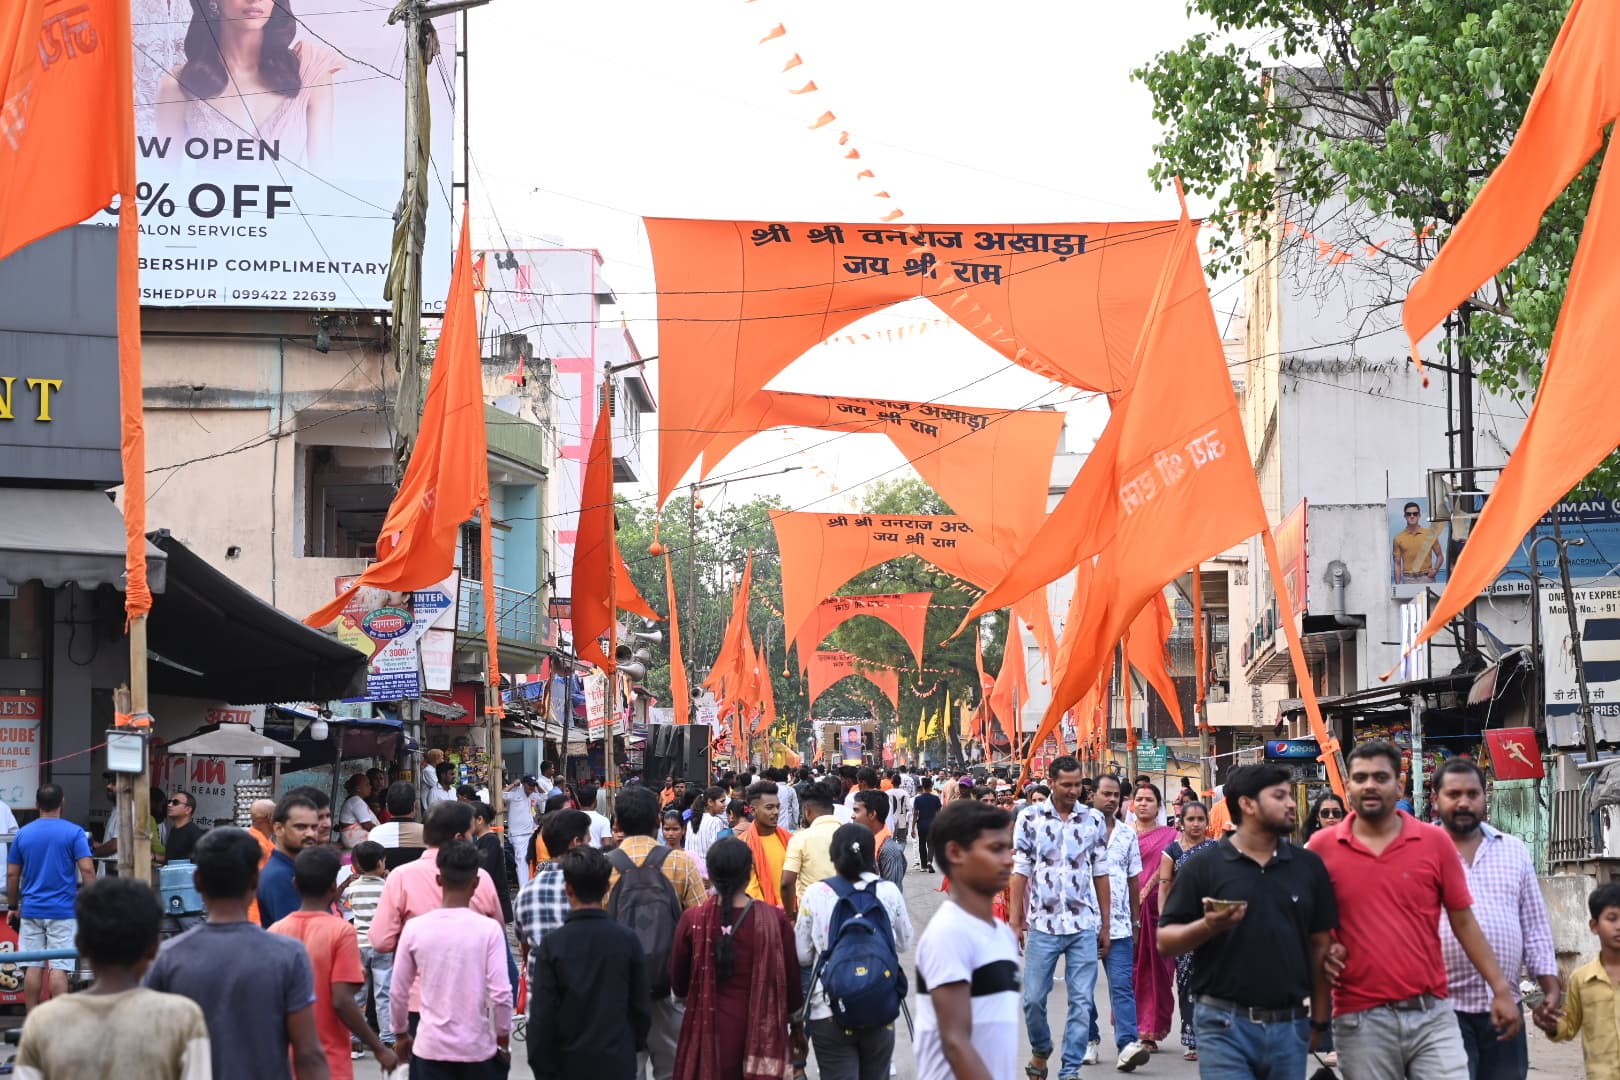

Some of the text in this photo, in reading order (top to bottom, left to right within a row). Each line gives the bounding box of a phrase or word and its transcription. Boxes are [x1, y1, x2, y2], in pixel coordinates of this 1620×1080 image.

[184, 137, 280, 161] OPEN
[188, 182, 293, 219] OFF
[138, 224, 268, 238] ALON SERVICES
[750, 223, 1088, 262] श्री श्री वनराज अखाड़ा
[138, 258, 388, 275] BERSHIP COMPLIMENTARY
[842, 255, 889, 275] जय
[950, 261, 1002, 286] राम
[138, 288, 337, 302] SHEDPUR 099422 22639
[836, 403, 867, 416] जय
[910, 420, 938, 438] राम
[1575, 591, 1586, 600] AY
[0, 701, 36, 716] ETS
[0, 746, 31, 756] LABLE
